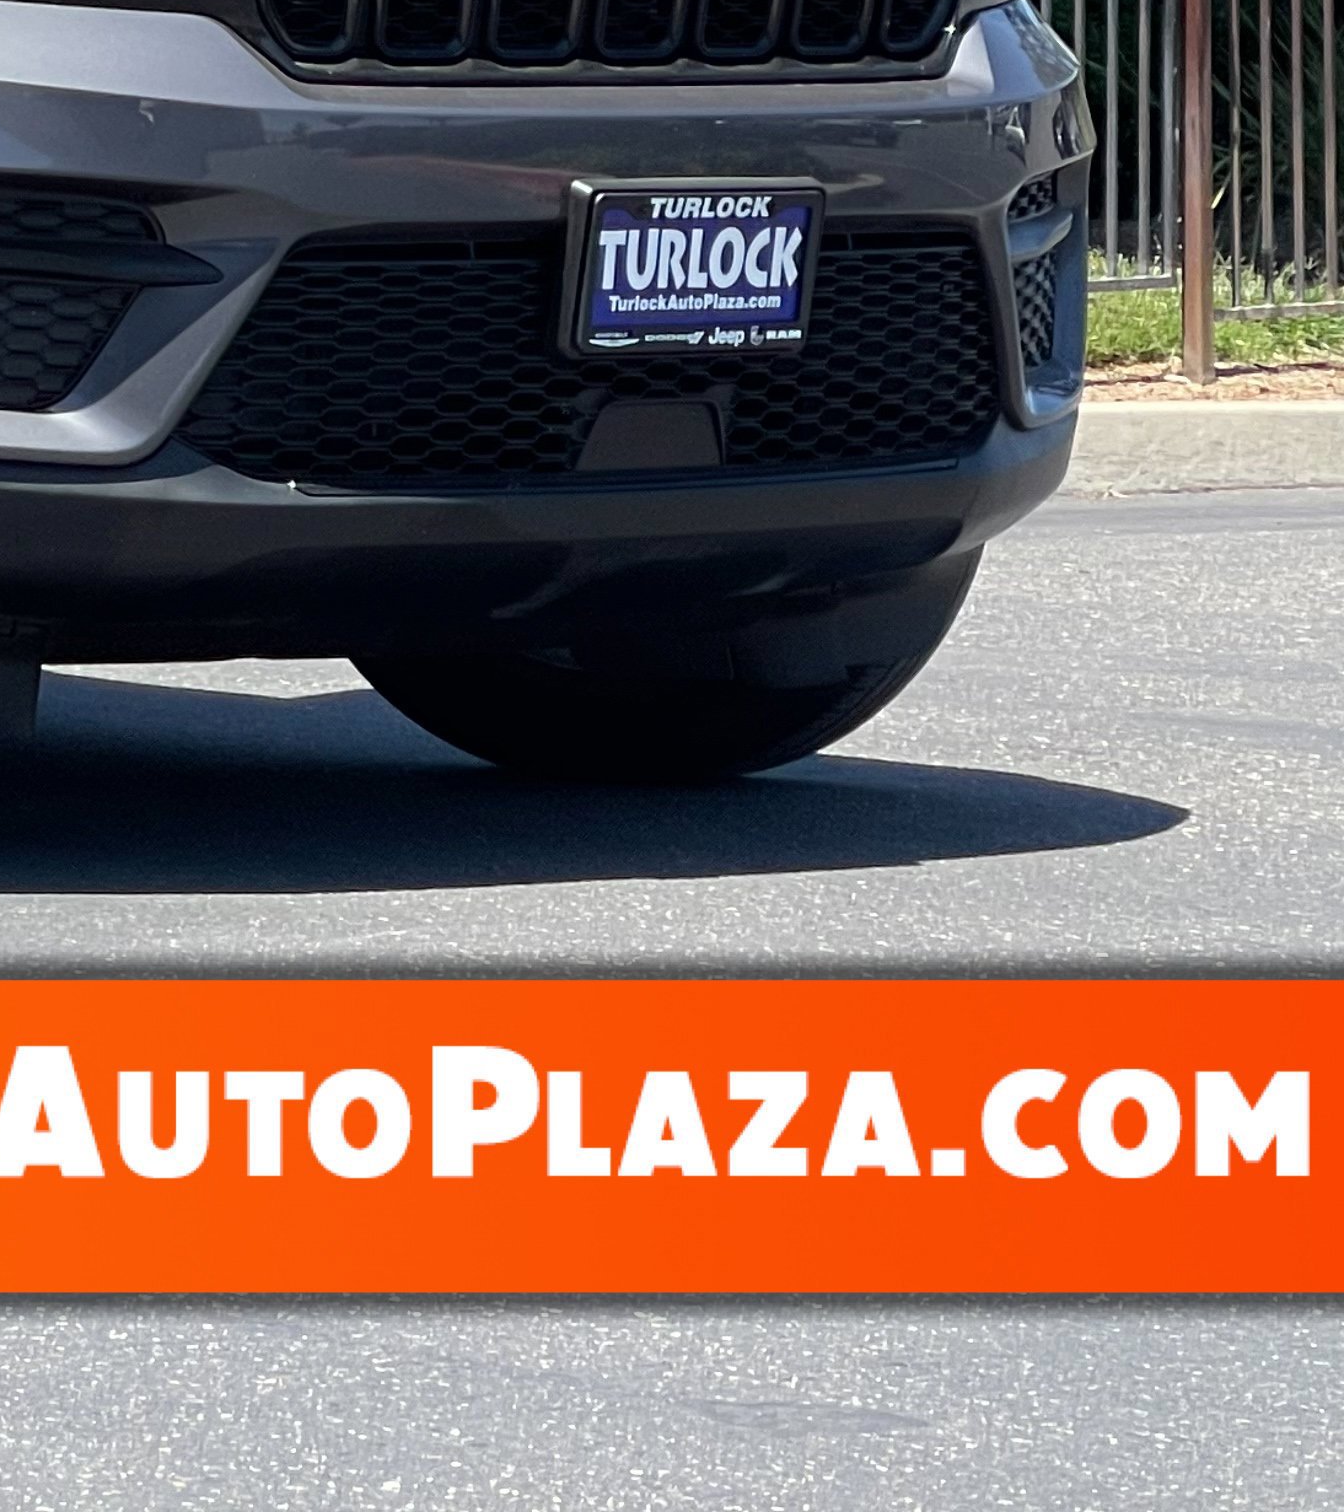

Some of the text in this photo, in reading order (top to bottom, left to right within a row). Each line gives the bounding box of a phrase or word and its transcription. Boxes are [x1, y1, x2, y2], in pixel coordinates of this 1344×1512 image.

[650, 196, 772, 219] TURLOCK
[599, 226, 803, 291] TURLOCK
[609, 293, 781, 312] TurlockAutoPlaza.com
[708, 327, 745, 347] Jeep
